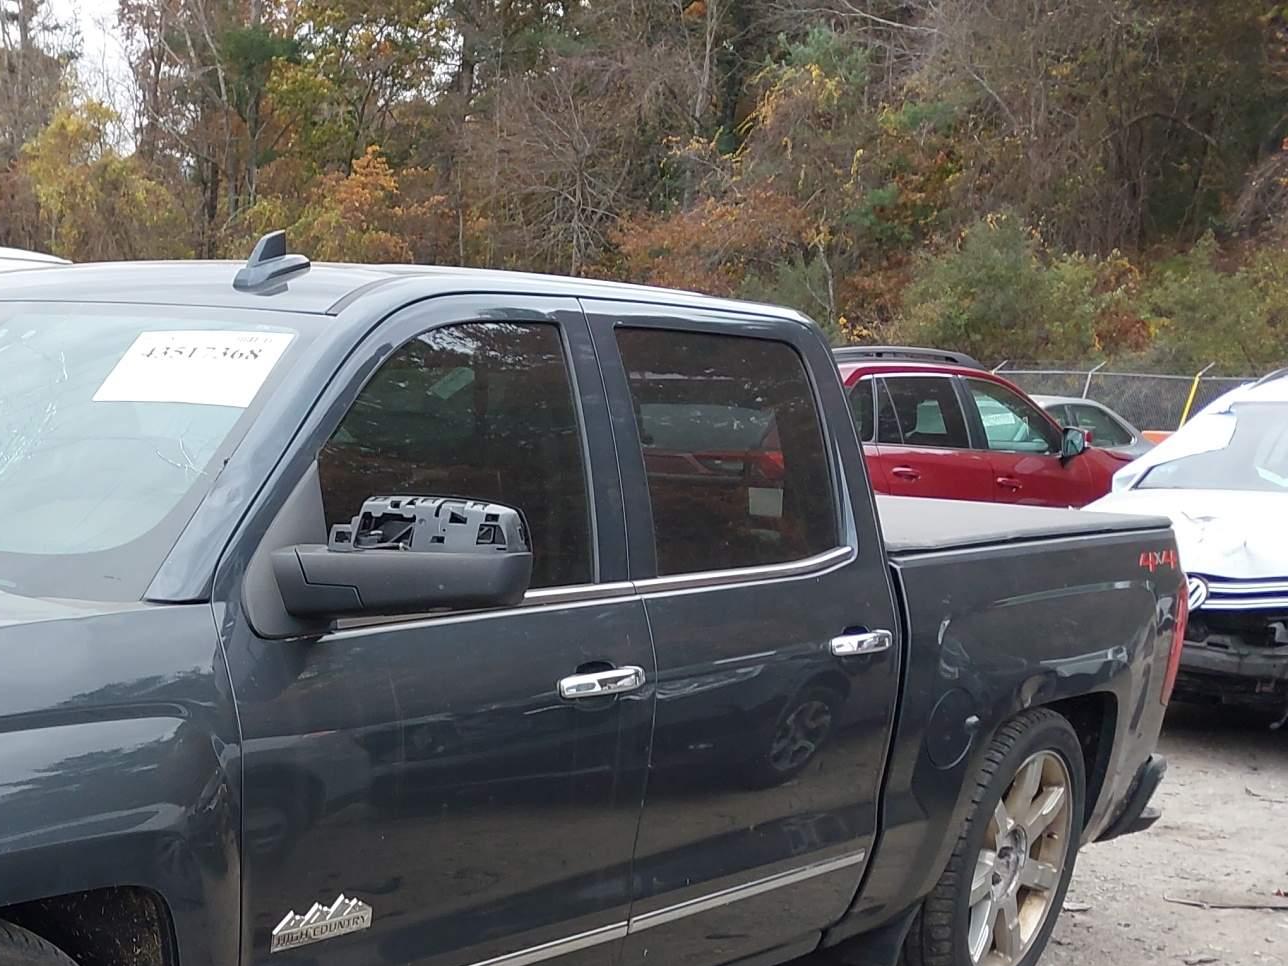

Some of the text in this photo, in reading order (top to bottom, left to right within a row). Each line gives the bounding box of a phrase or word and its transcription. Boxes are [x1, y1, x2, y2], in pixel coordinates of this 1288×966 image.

[142, 346, 262, 361] 43517368
[273, 914, 369, 946] HIGH COUNTRY
